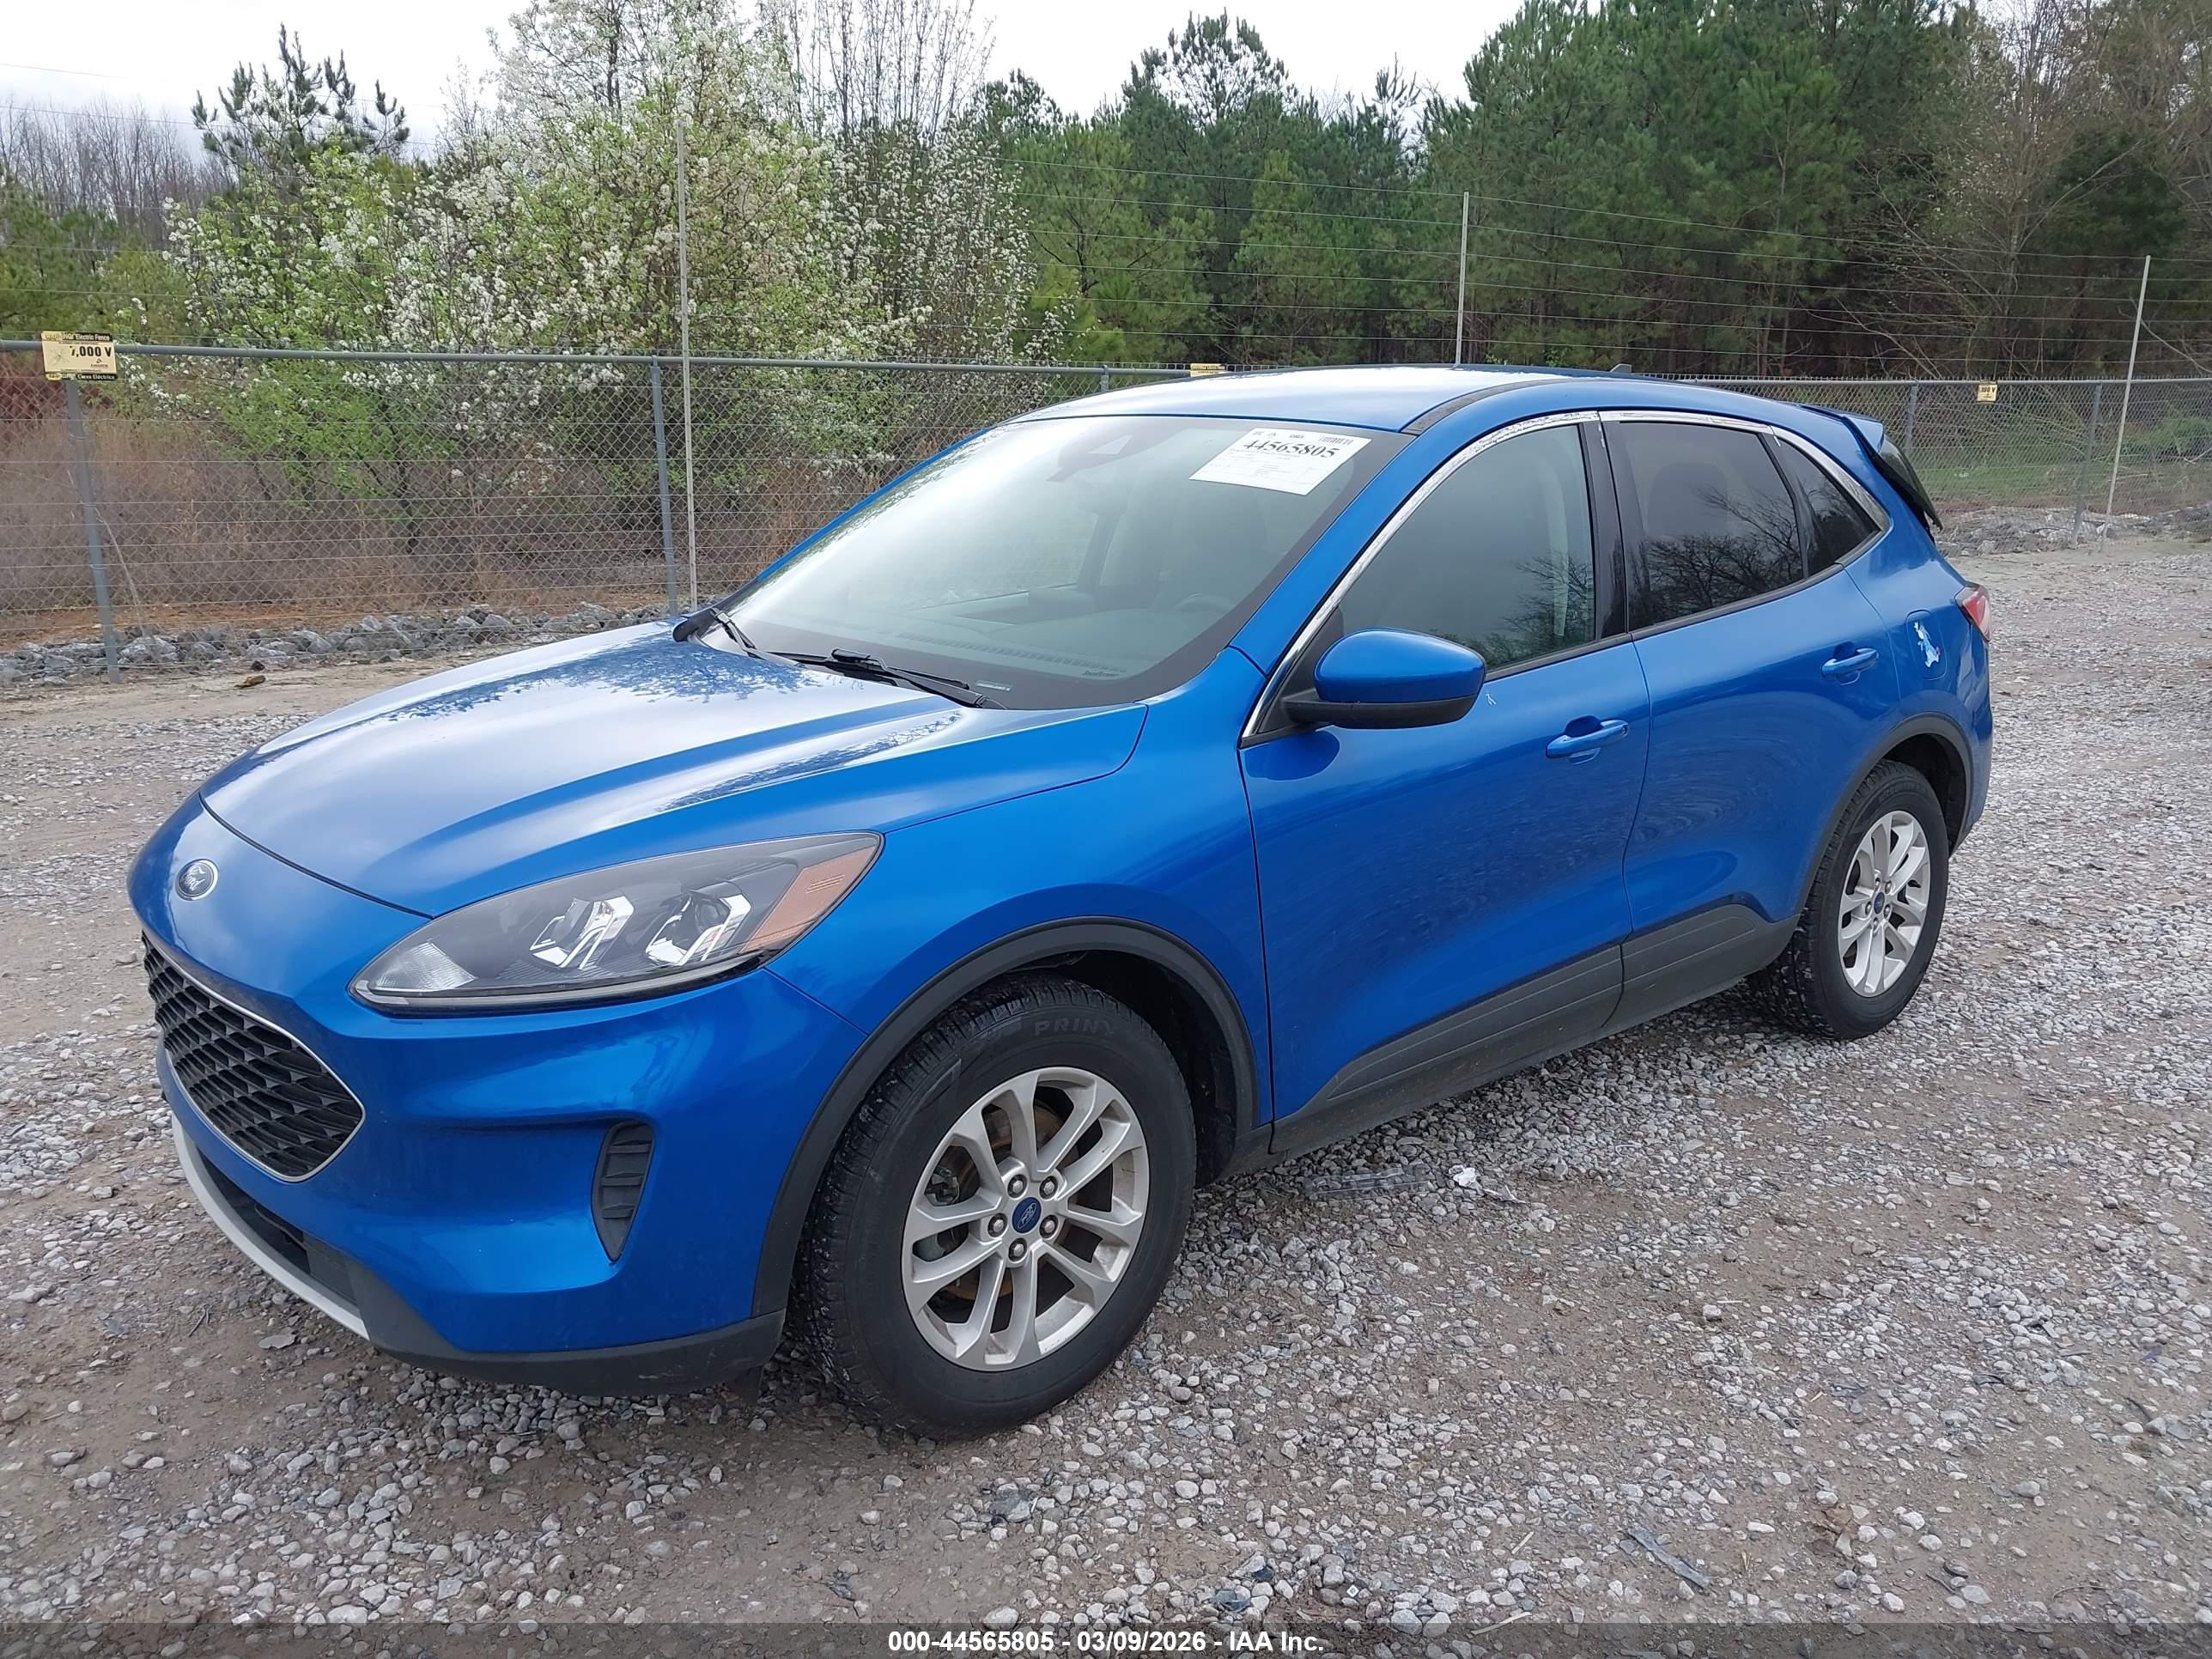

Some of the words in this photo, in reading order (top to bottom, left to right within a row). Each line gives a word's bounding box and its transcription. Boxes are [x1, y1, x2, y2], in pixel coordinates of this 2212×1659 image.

[69, 345, 102, 357] 7,000
[104, 346, 112, 357] V
[1243, 439, 1340, 459] 44565805
